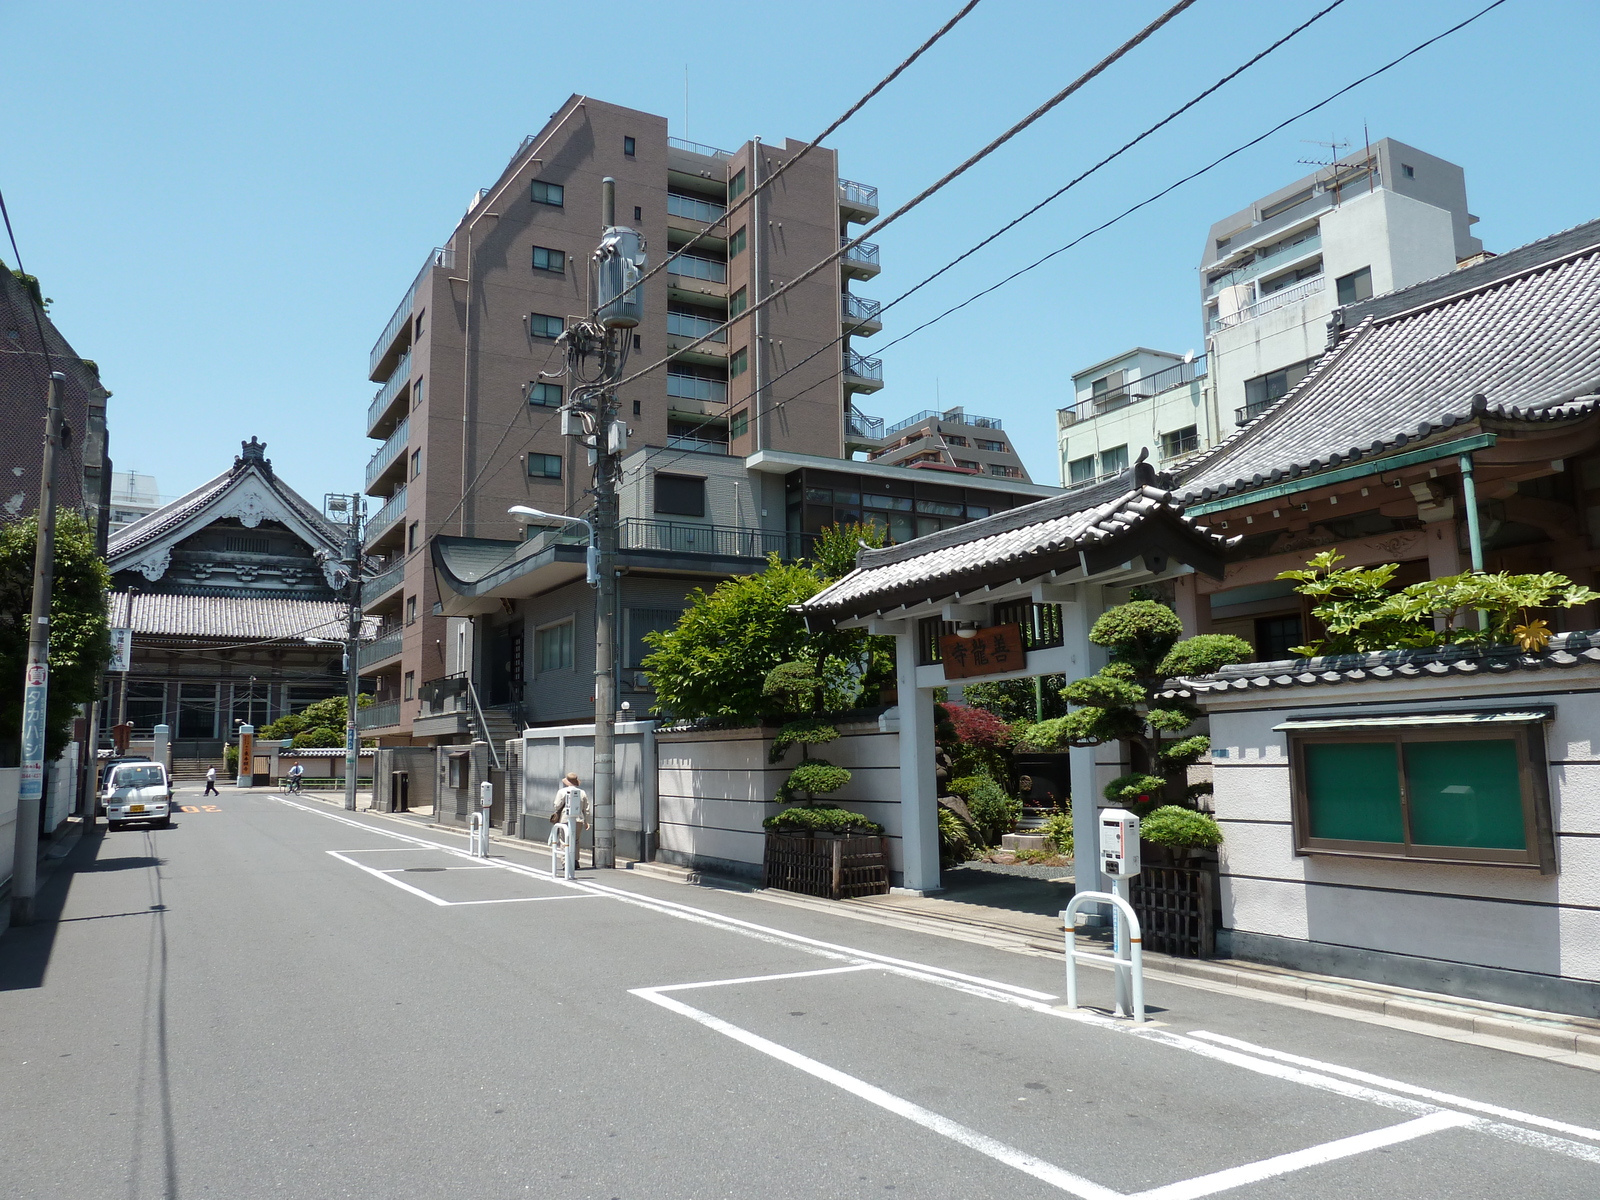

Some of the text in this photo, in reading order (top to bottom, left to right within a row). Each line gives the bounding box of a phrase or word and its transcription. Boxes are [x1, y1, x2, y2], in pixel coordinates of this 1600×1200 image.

[951, 634, 1010, 667] 善龍寺
[26, 691, 41, 757] タカハシ
